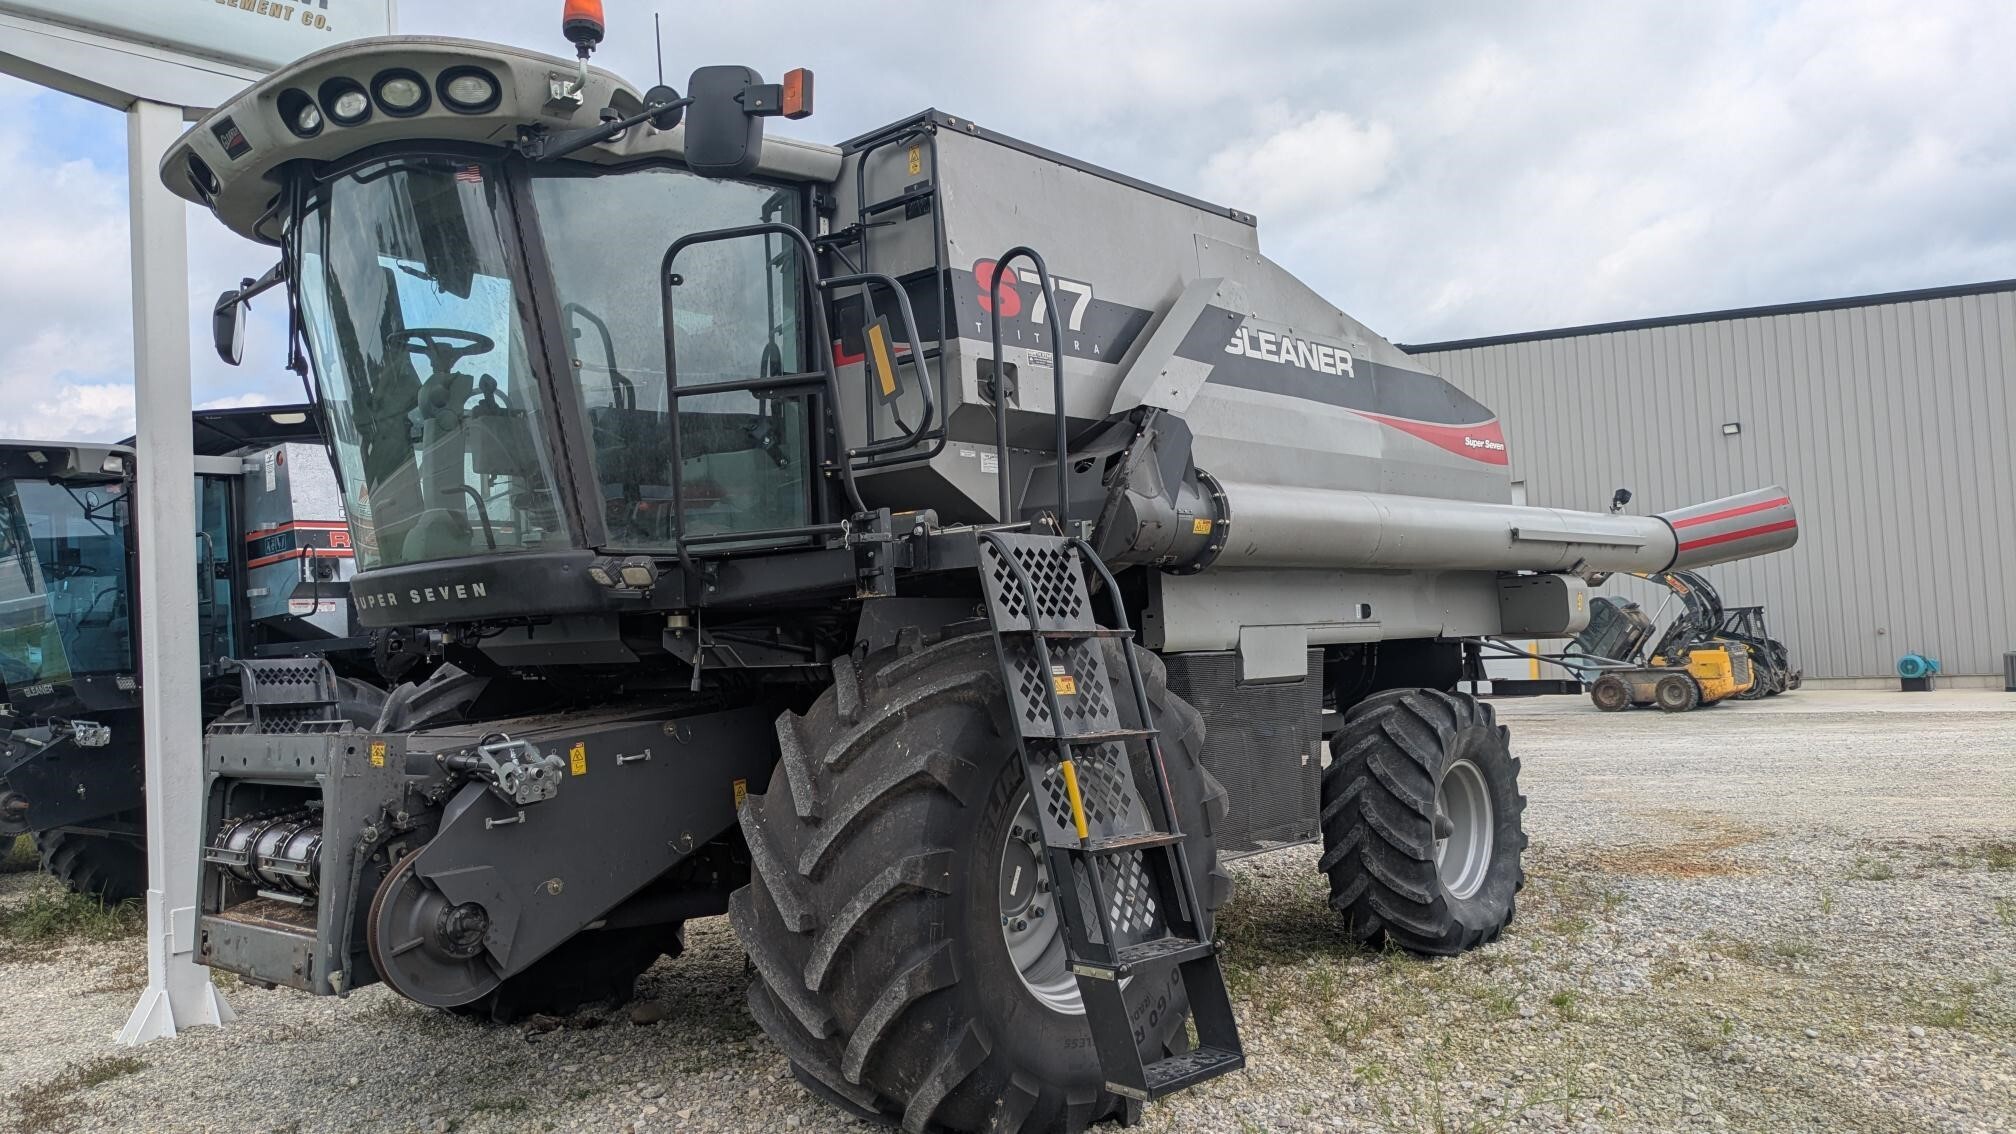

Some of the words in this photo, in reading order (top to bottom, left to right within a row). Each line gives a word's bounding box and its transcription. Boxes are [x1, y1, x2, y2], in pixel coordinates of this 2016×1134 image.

[302, 11, 332, 31] CO.
[973, 258, 1092, 332] S77
[1465, 436, 1484, 448] Super
[1485, 440, 1504, 450] Seven
[409, 582, 487, 603] SEVEN
[24, 683, 54, 697] GLEANER
